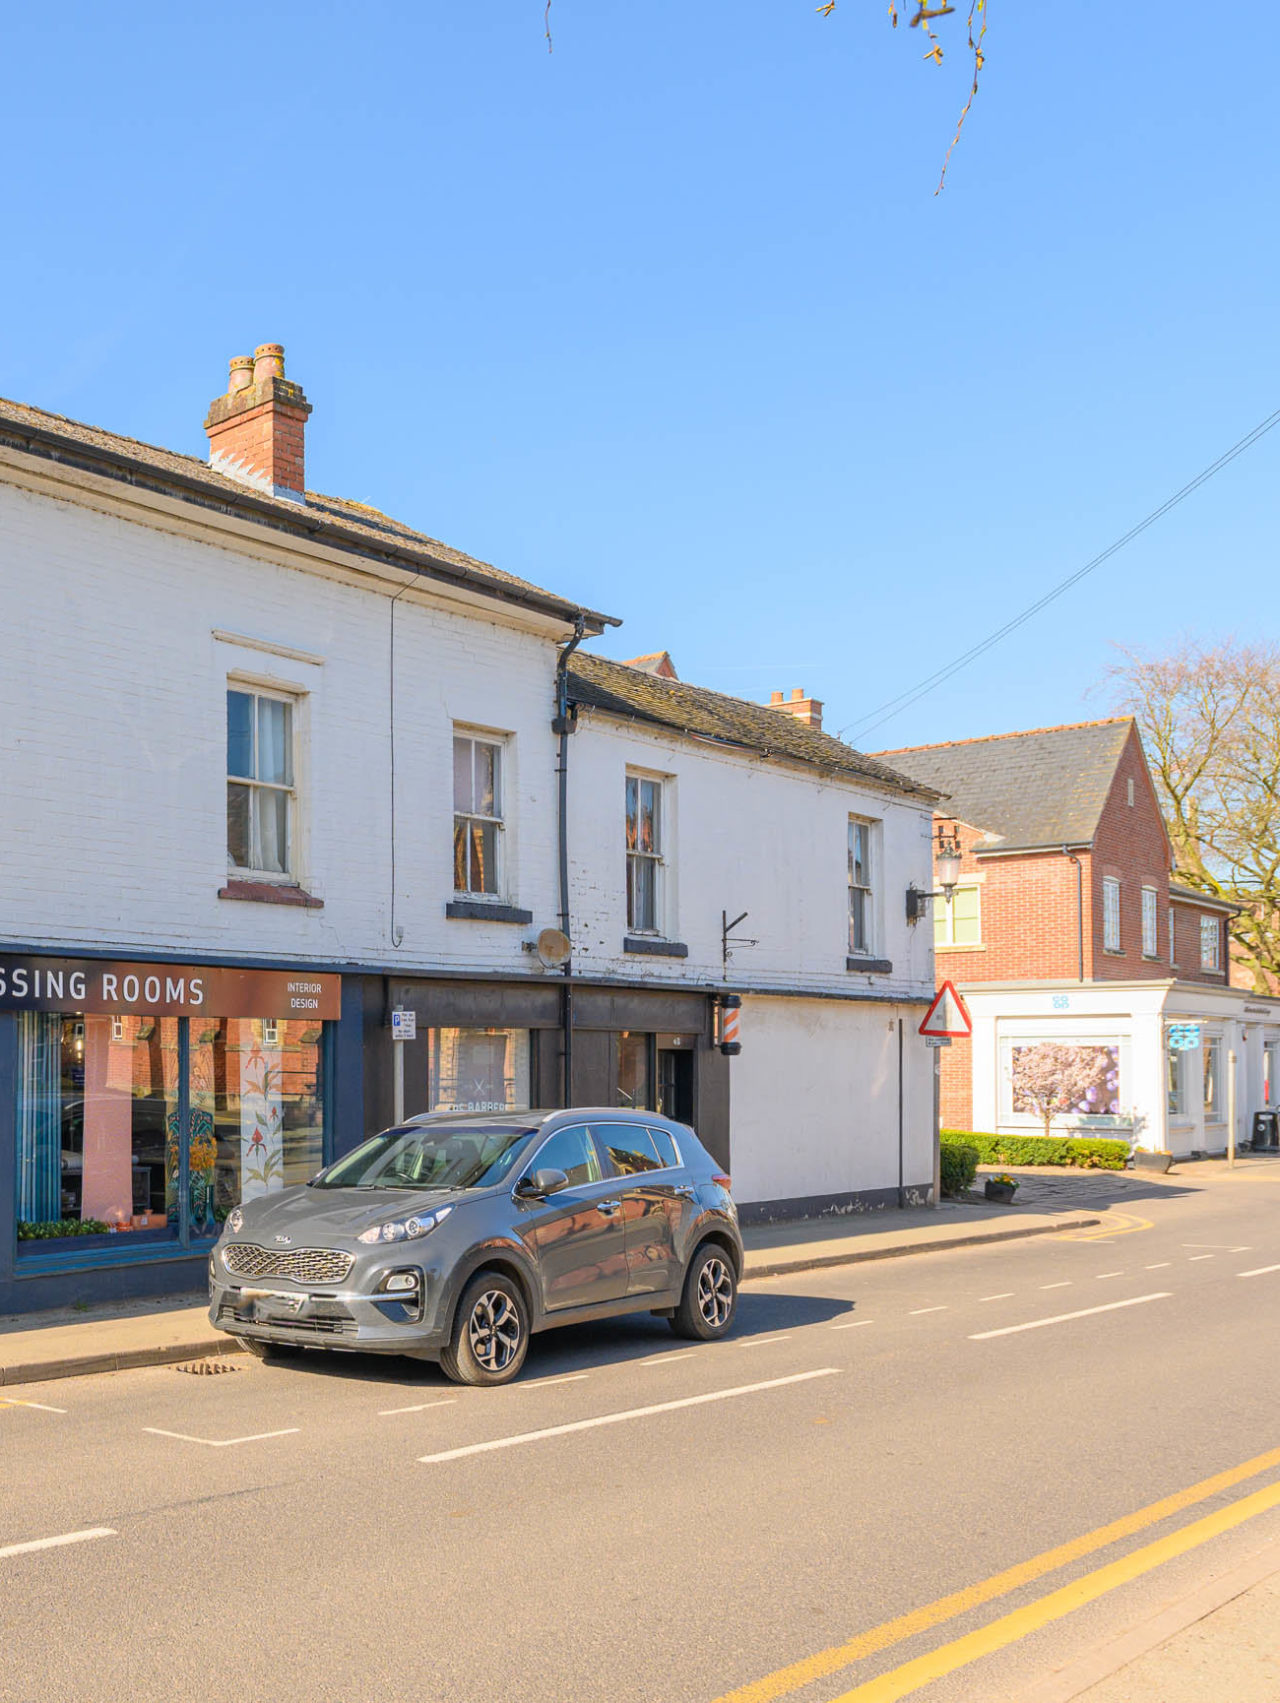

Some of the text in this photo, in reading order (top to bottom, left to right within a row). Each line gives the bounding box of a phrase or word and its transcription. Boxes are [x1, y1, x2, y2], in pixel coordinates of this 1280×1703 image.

[102, 973, 204, 1005] ROOMS
[287, 982, 322, 994] INTERIOR
[290, 998, 318, 1009] DESIGN
